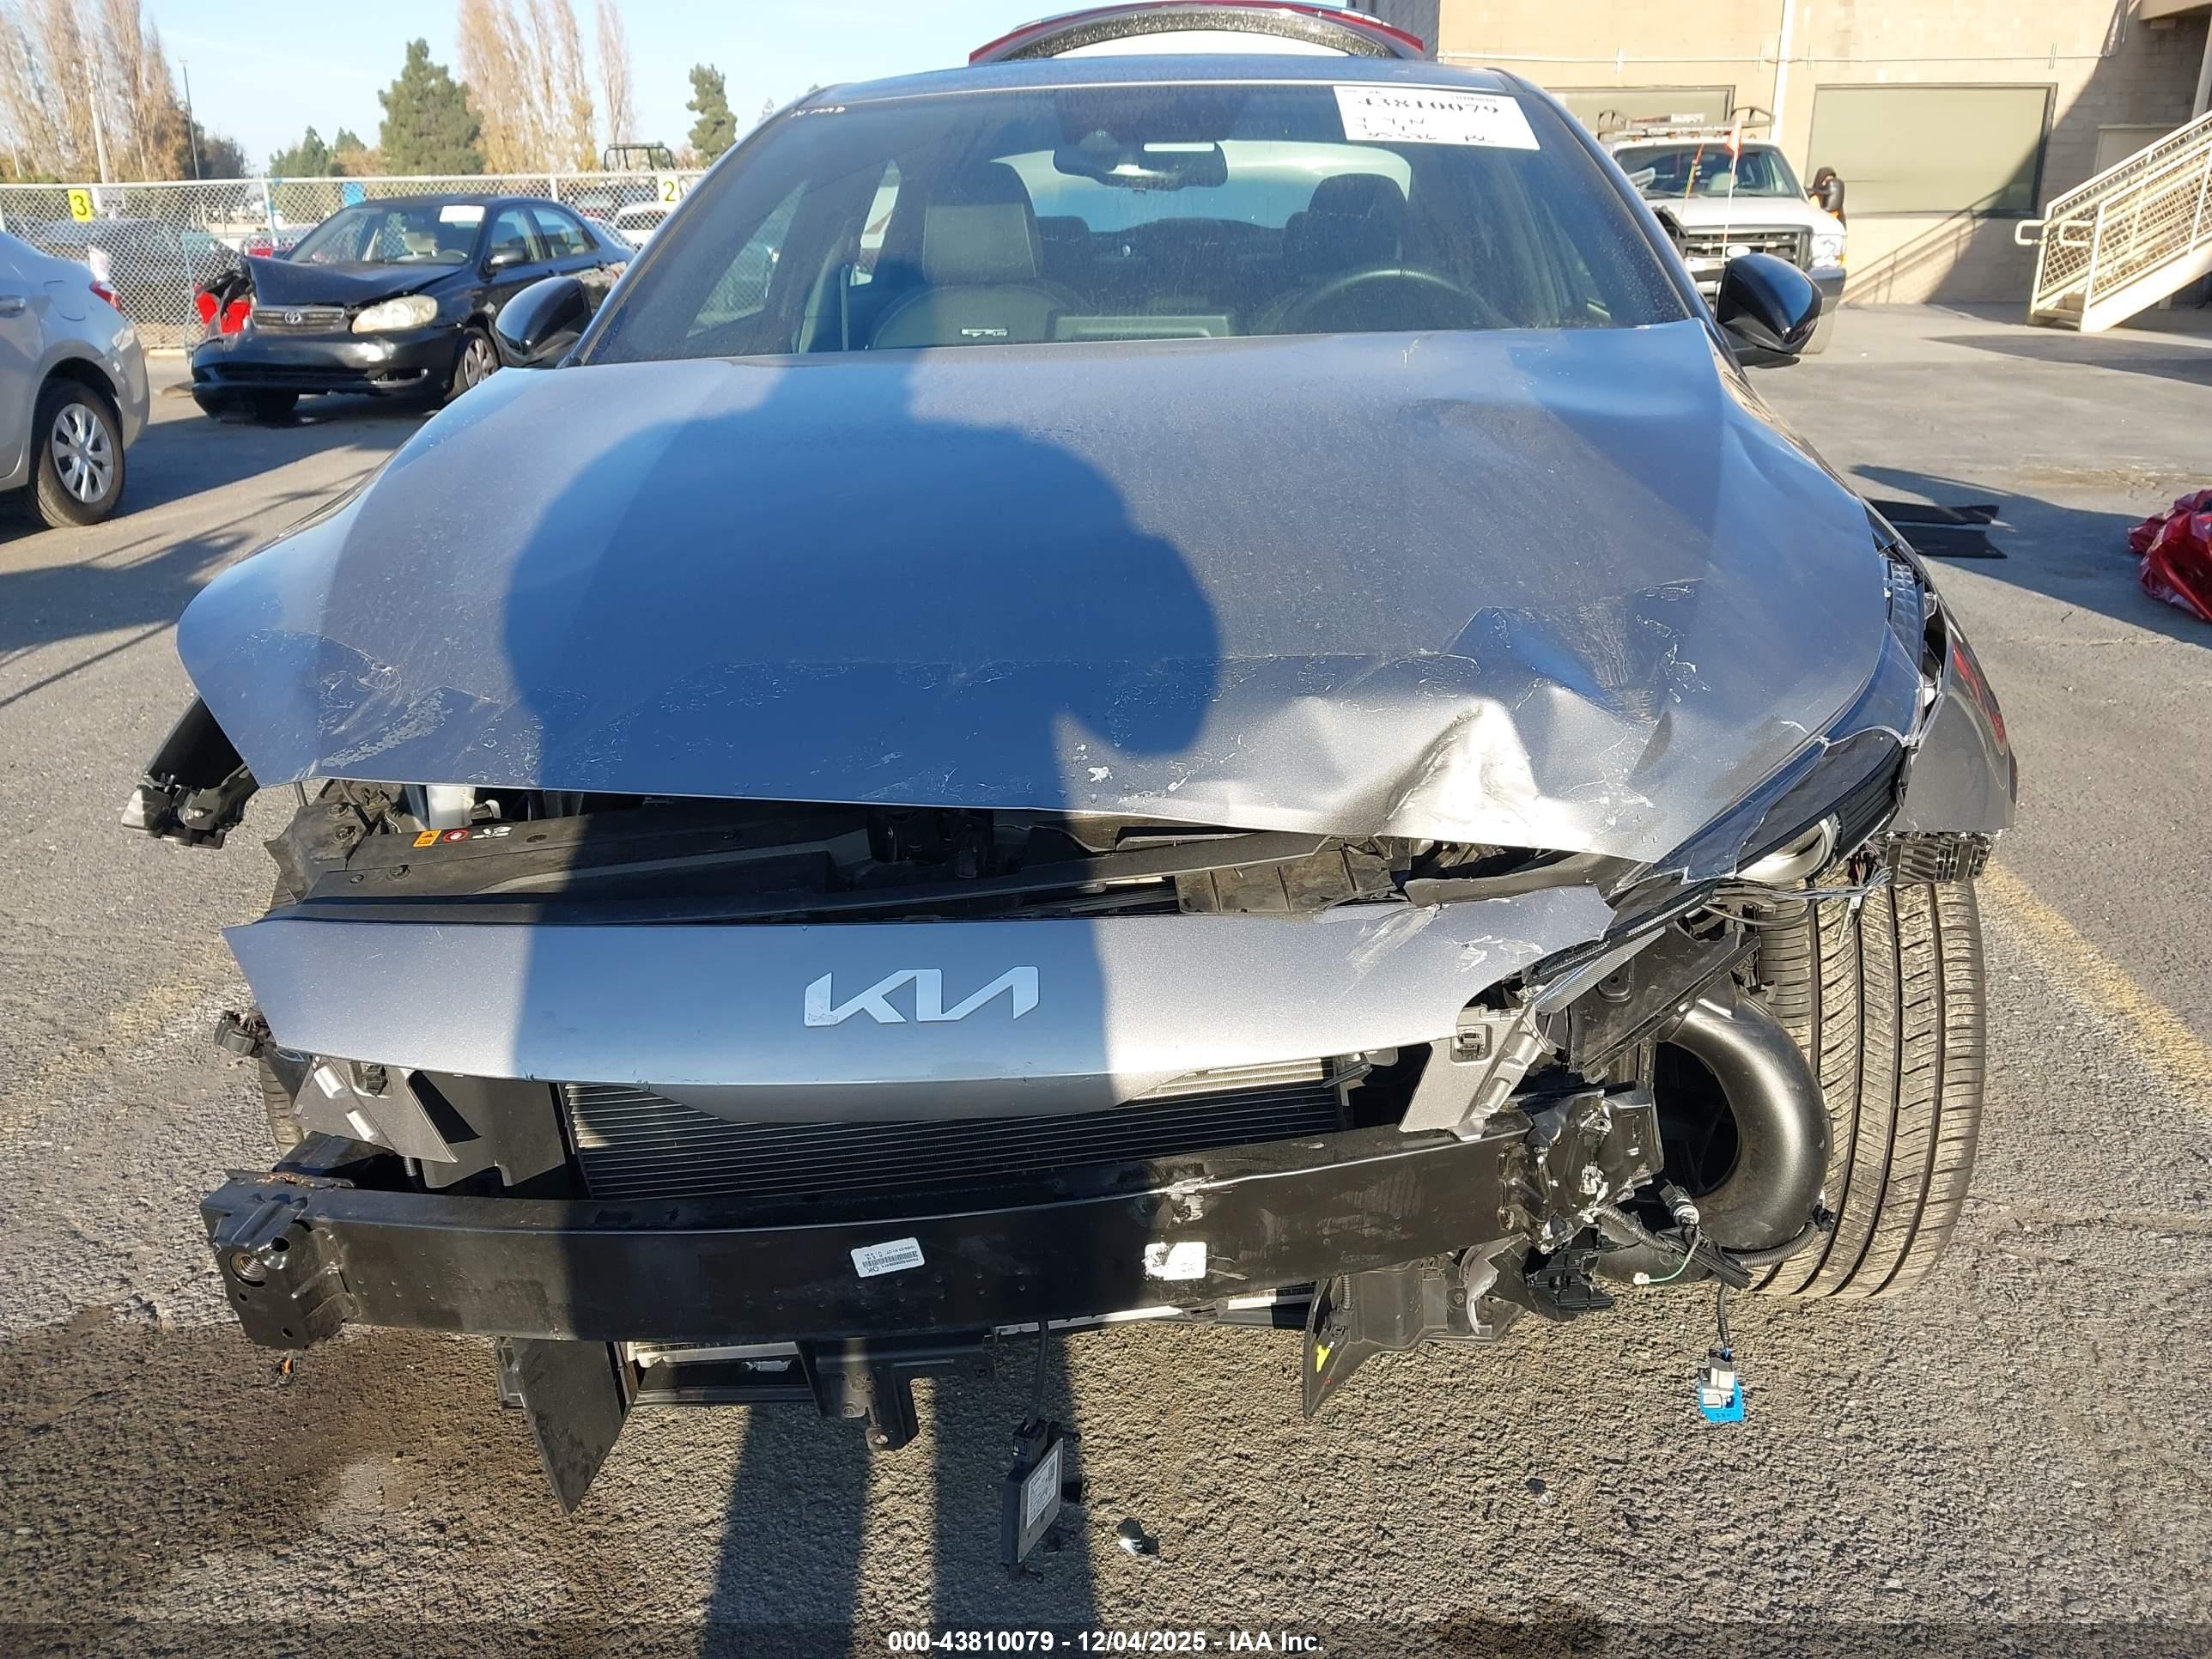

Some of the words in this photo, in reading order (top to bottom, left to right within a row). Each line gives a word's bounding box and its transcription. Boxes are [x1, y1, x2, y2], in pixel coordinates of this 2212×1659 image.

[663, 180, 677, 202] 2
[73, 195, 88, 216] 3
[803, 965, 1040, 1028] KIA
